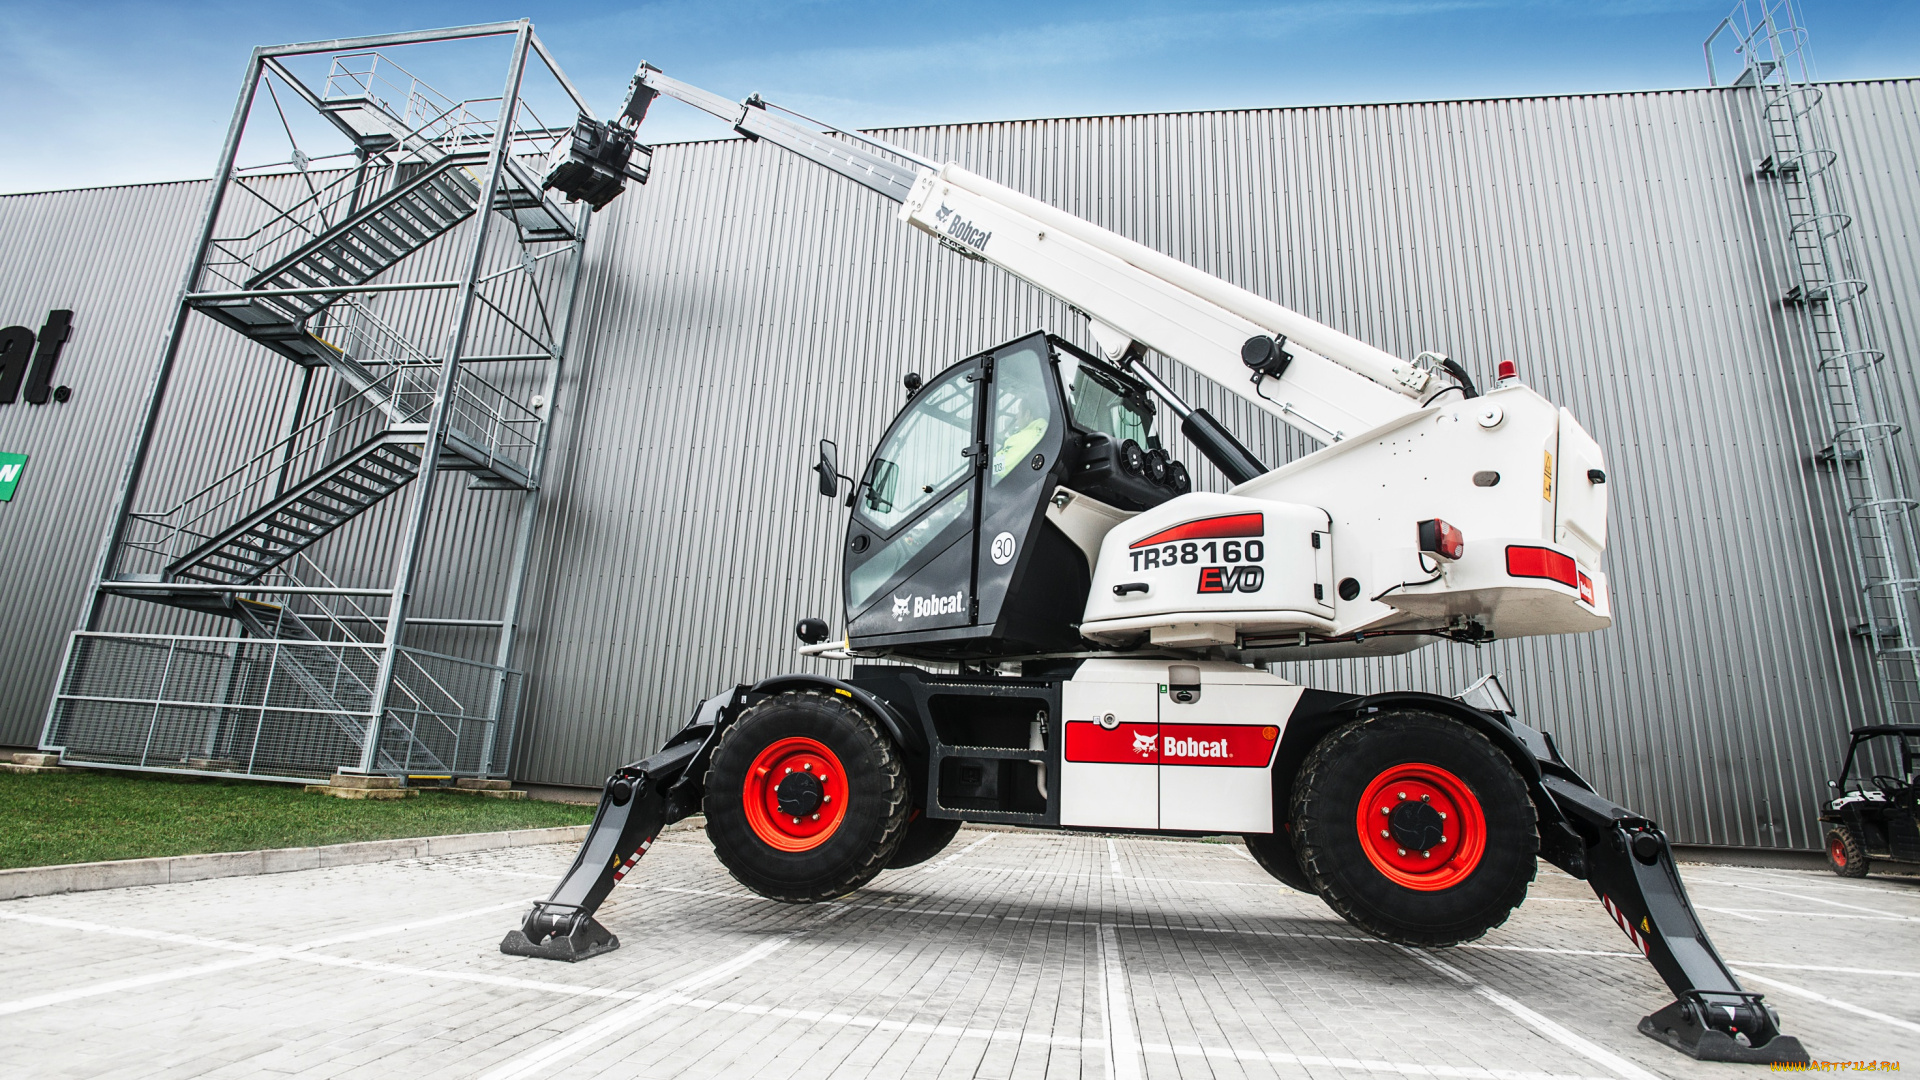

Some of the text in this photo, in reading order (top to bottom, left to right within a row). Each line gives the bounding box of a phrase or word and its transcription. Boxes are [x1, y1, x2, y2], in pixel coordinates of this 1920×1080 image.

[865, 164, 875, 176] H
[947, 214, 992, 251] Bobcat
[994, 537, 1013, 560] 30
[1129, 540, 1264, 572] TR38160
[1197, 565, 1264, 594] EVO
